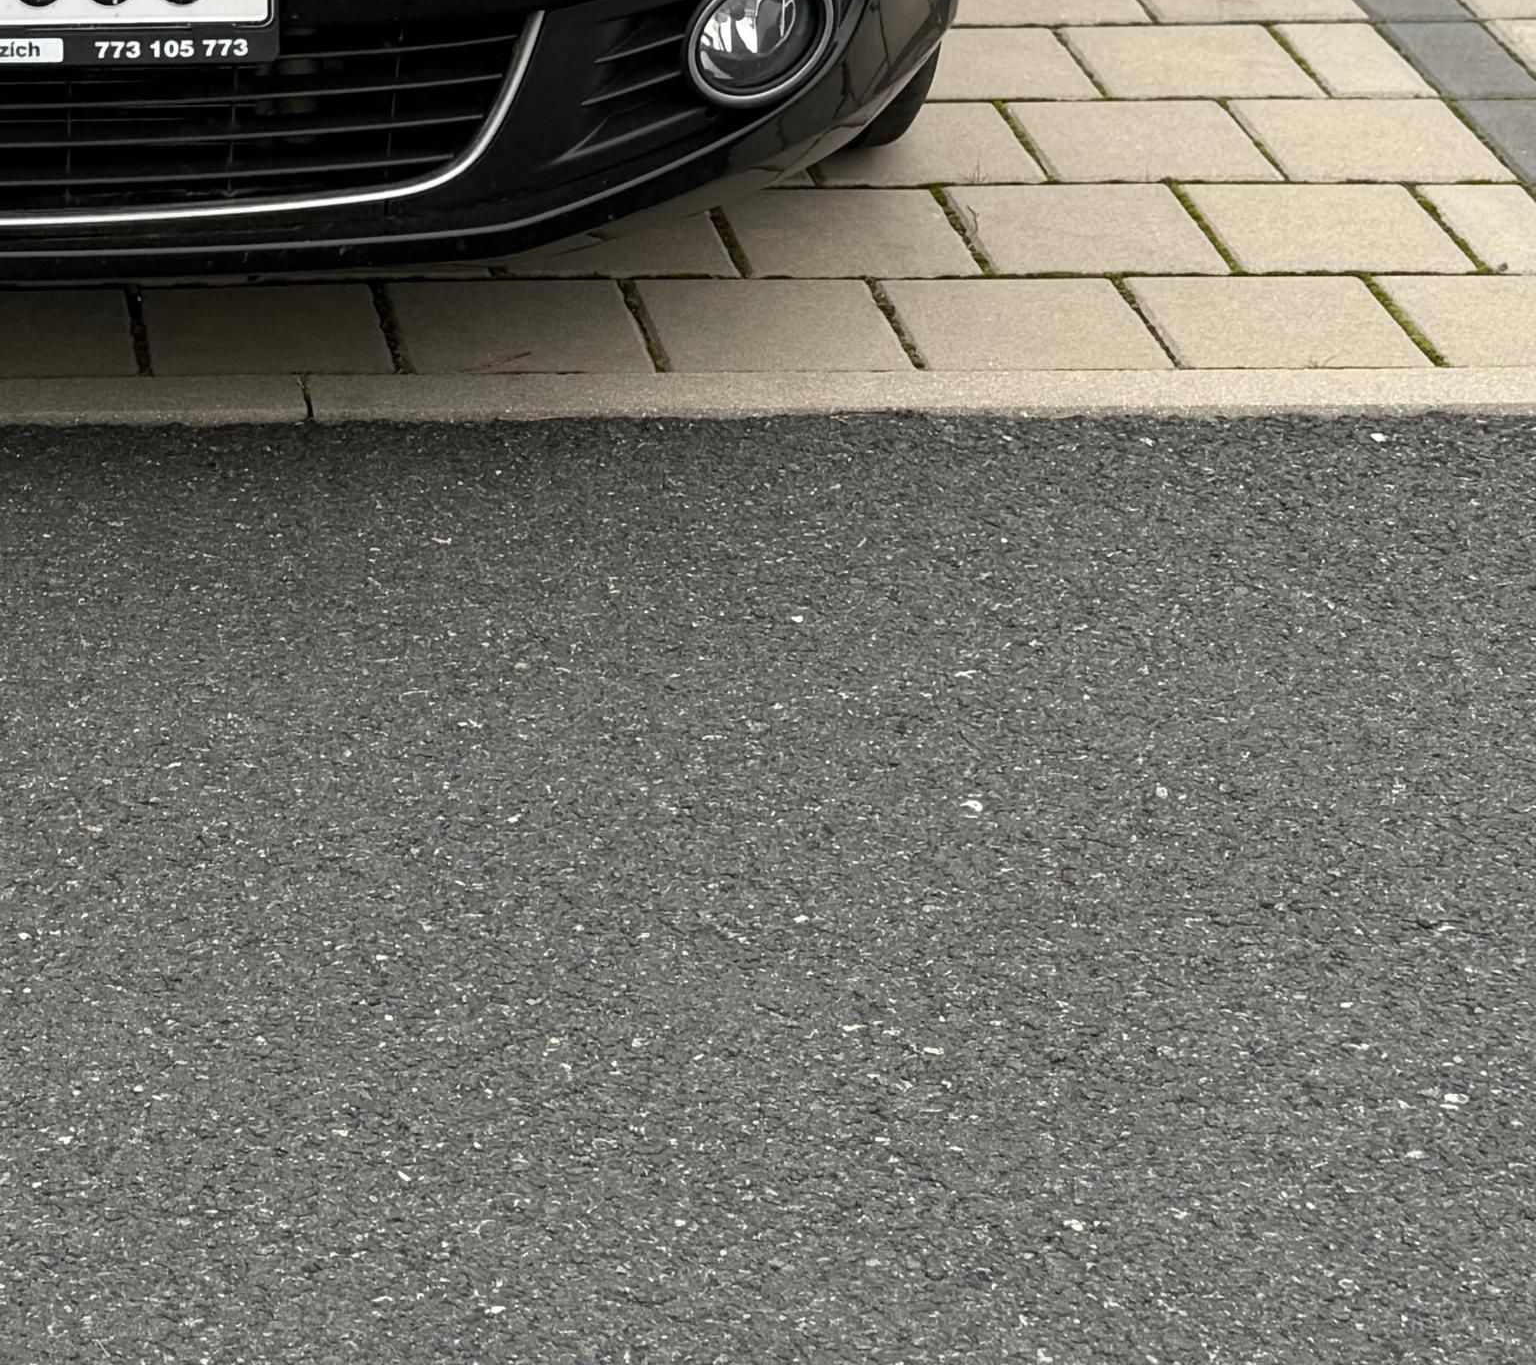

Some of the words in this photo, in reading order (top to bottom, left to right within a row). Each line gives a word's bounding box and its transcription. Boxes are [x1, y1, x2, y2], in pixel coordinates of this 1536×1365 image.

[94, 41, 142, 59] 773
[149, 40, 195, 58] 105
[202, 38, 249, 57] 773
